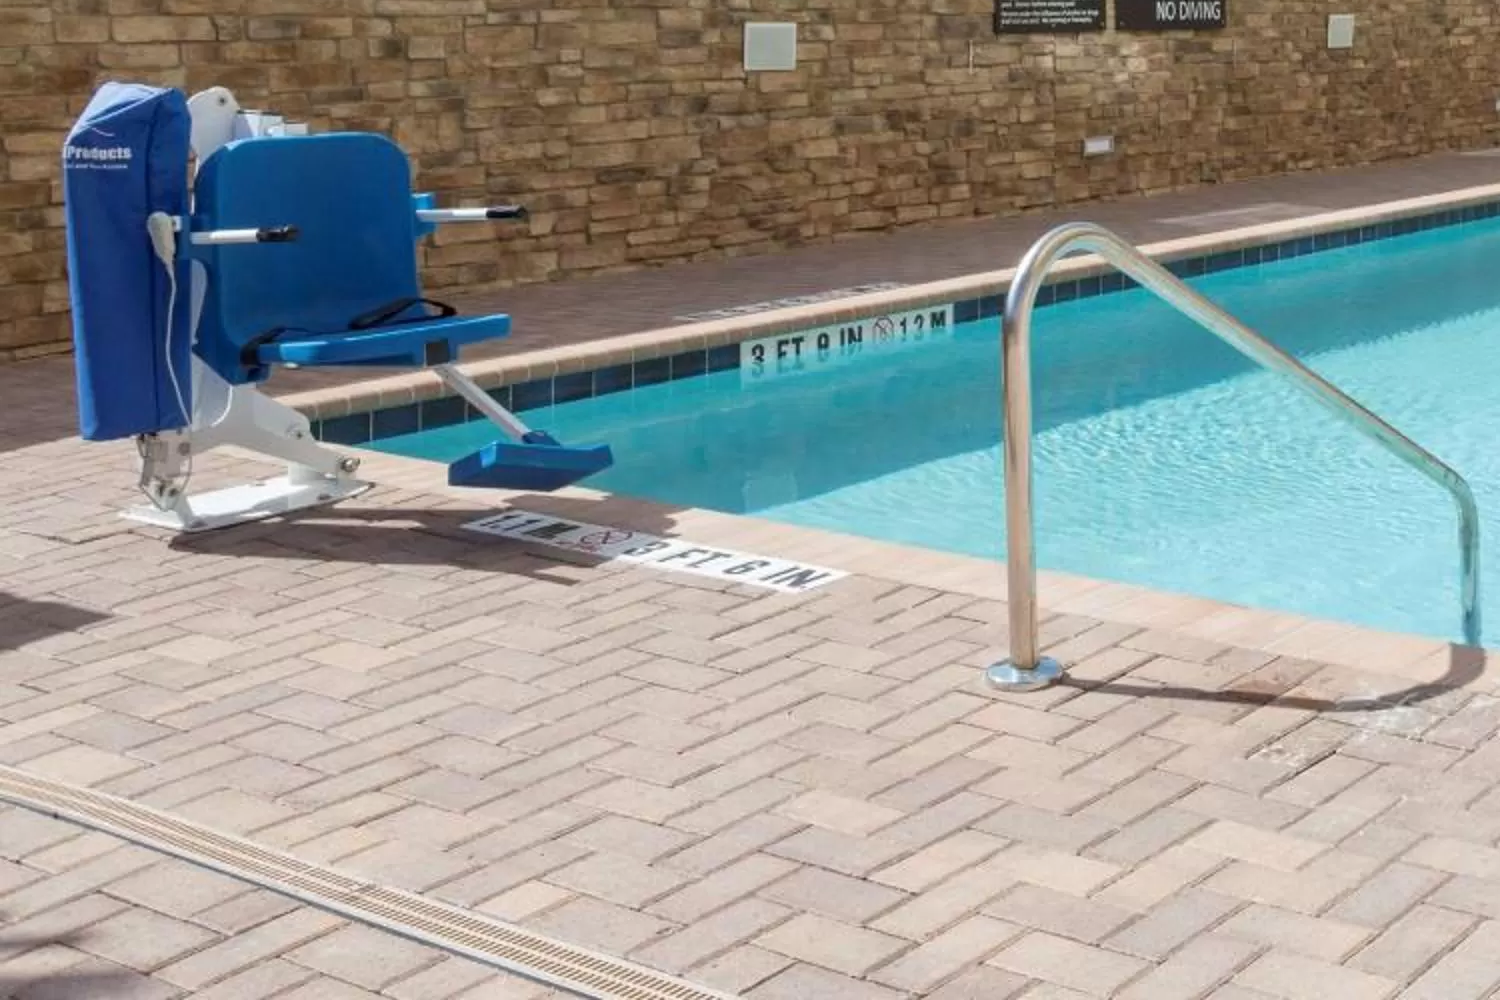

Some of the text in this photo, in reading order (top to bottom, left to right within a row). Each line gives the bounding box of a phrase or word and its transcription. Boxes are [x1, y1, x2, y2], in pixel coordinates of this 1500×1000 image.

[1156, 0, 1221, 21] NO DIVING
[777, 335, 805, 360] FT
[839, 324, 864, 347] IN
[930, 309, 947, 329] M
[658, 547, 732, 569] FT
[722, 559, 772, 575] 6
[758, 566, 833, 588] IN
